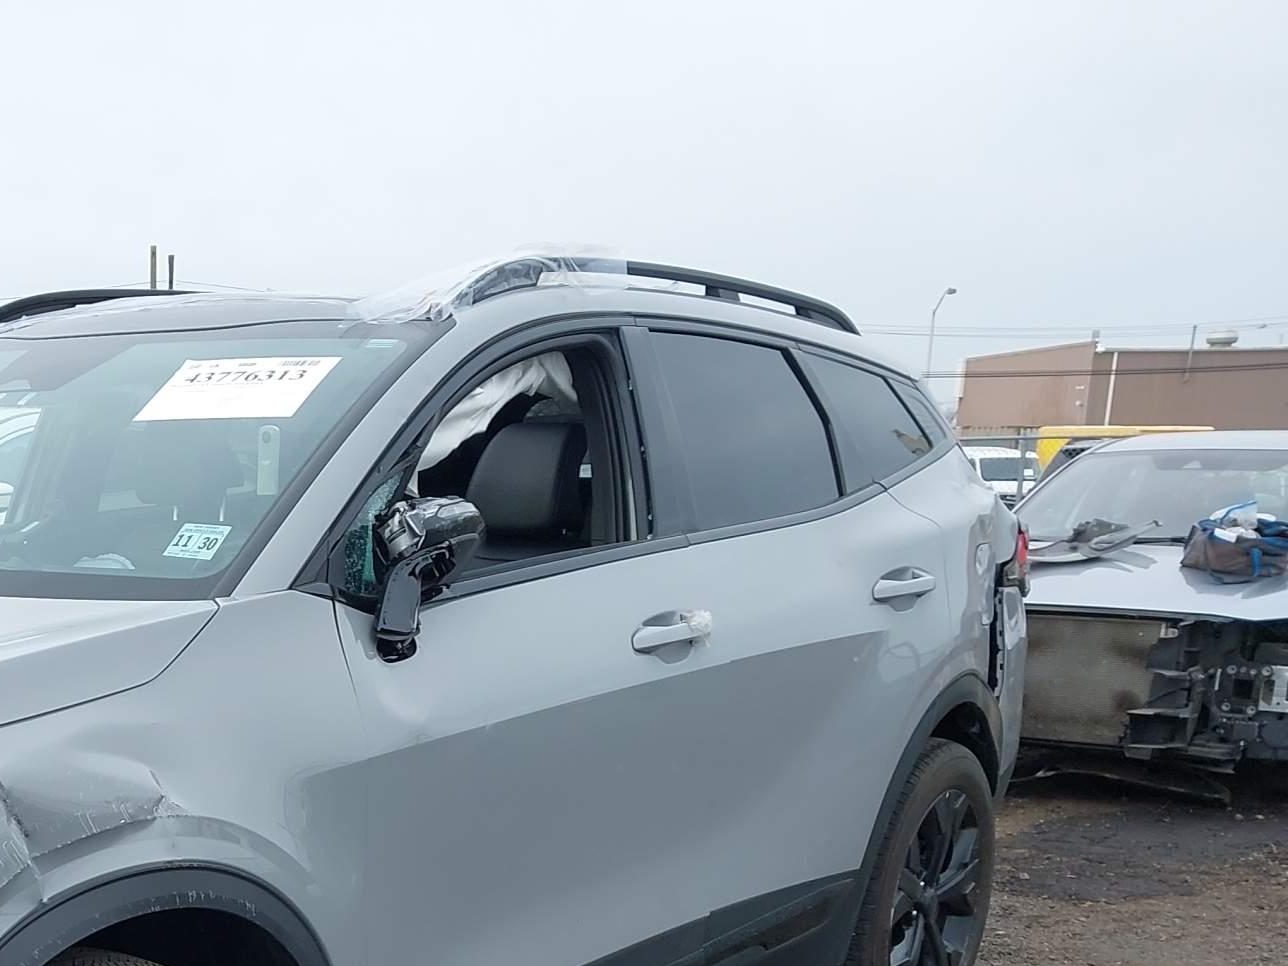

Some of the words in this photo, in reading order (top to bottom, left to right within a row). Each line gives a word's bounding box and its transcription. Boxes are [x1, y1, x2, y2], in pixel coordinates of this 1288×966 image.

[184, 369, 308, 384] 43776313
[172, 534, 194, 548] 11
[197, 536, 219, 551] 30
